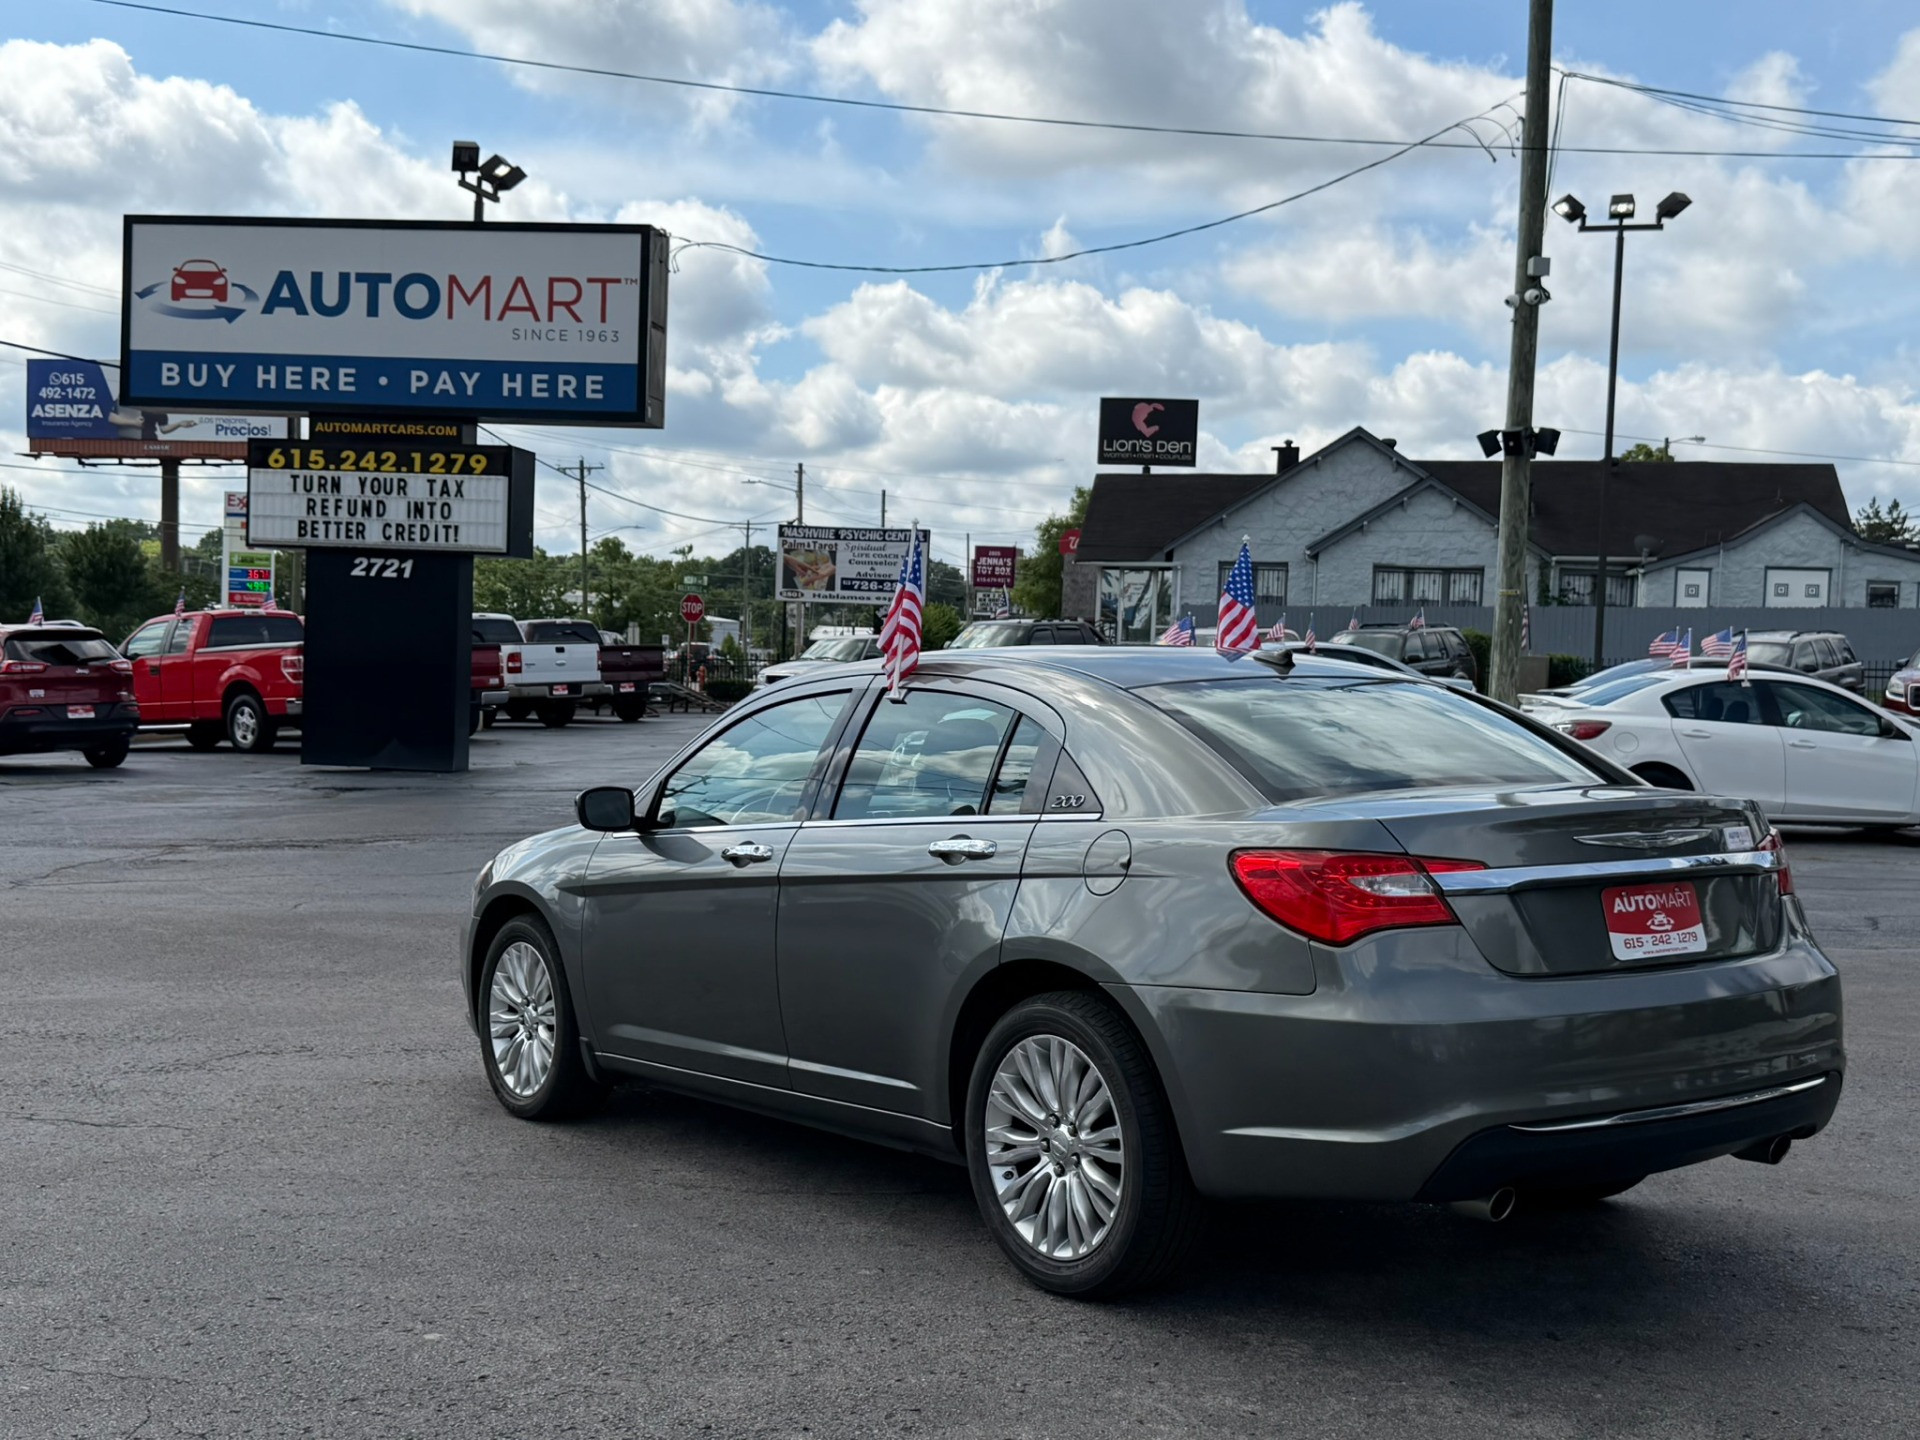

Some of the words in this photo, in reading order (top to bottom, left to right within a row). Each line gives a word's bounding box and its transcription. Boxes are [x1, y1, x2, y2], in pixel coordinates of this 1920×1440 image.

[260, 270, 622, 324] AUTOMART
[511, 327, 570, 343] SINCE
[578, 329, 621, 344] 1963
[61, 373, 85, 385] 615
[161, 362, 237, 389] BUY
[256, 365, 358, 393] HERE
[410, 369, 481, 397] PAY
[502, 373, 606, 400] HERE
[39, 386, 96, 400] 492-1472
[31, 403, 104, 419] ASENZA
[215, 423, 273, 437] Precios!
[314, 421, 458, 437] AUTOMARTCARS.COM
[267, 447, 489, 475] 615.242.1279
[289, 475, 344, 495] TURN
[358, 477, 409, 498] YOUR
[427, 479, 465, 499] TAX
[306, 500, 387, 520] REFUND
[406, 502, 452, 521] INTO
[297, 519, 367, 540] BETTER
[382, 522, 460, 544] CREDIT!
[838, 529, 884, 540] PSYCHIC
[885, 530, 925, 542] CENTR
[782, 540, 805, 549] Palm
[812, 540, 838, 550] Tarot
[843, 541, 888, 552] Spiritual
[350, 557, 414, 579] 2721
[848, 559, 898, 567] Counselor
[977, 557, 1012, 566] JENNA'S
[855, 571, 894, 579] Advisor
[977, 566, 993, 575] TOY
[994, 567, 1012, 576] BOX
[812, 592, 871, 601] Hablamos
[682, 602, 703, 614] STOP
[1051, 794, 1085, 808] 200
[1613, 891, 1692, 913] AUTOMART
[1623, 937, 1645, 949] 615
[1651, 935, 1673, 947] 242
[1677, 932, 1698, 943] 1279
